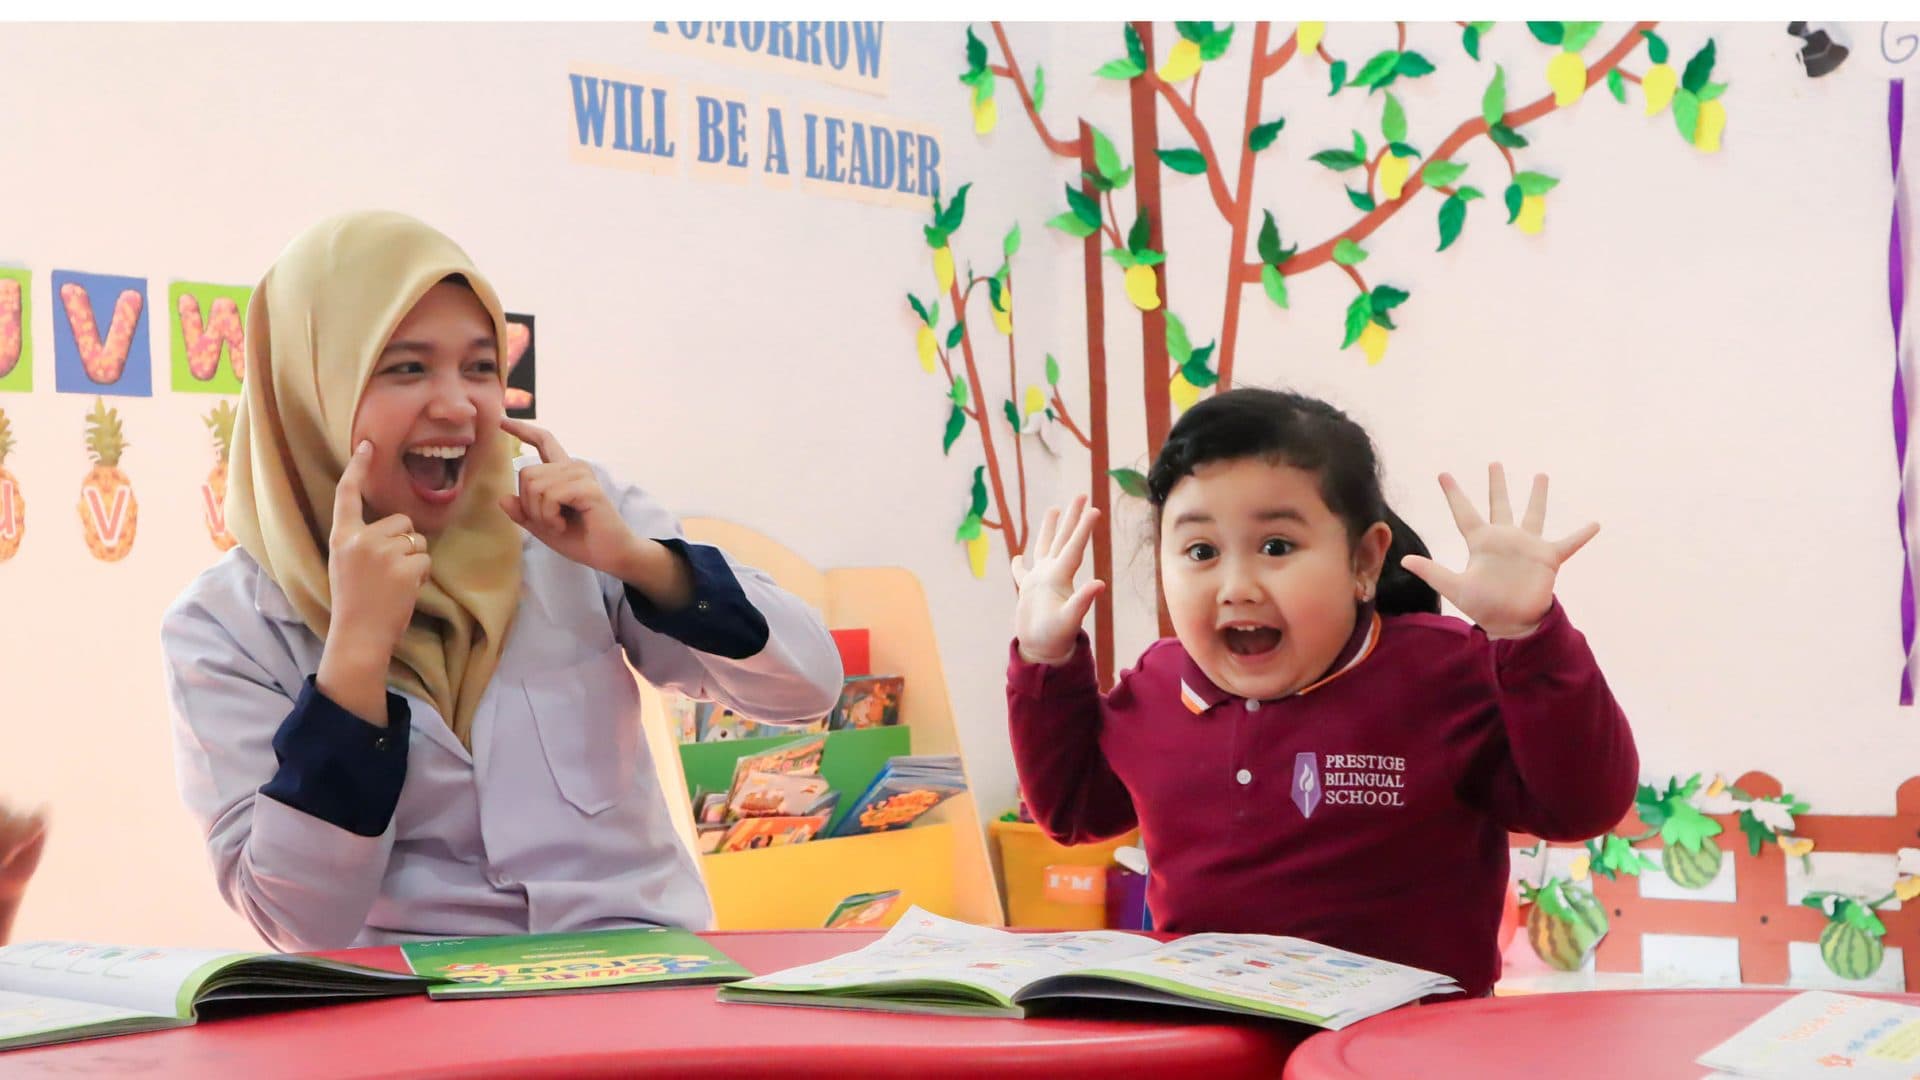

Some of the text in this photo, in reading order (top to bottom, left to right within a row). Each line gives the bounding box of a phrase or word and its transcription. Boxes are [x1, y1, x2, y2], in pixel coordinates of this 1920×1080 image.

[653, 21, 884, 79] RROW
[568, 73, 941, 197] WILL BE A LEADER
[60, 282, 144, 385] V
[1324, 754, 1406, 771] PRESTIGE
[1324, 772, 1405, 788] BILINGUAL
[1324, 790, 1405, 807] SCHOOL
